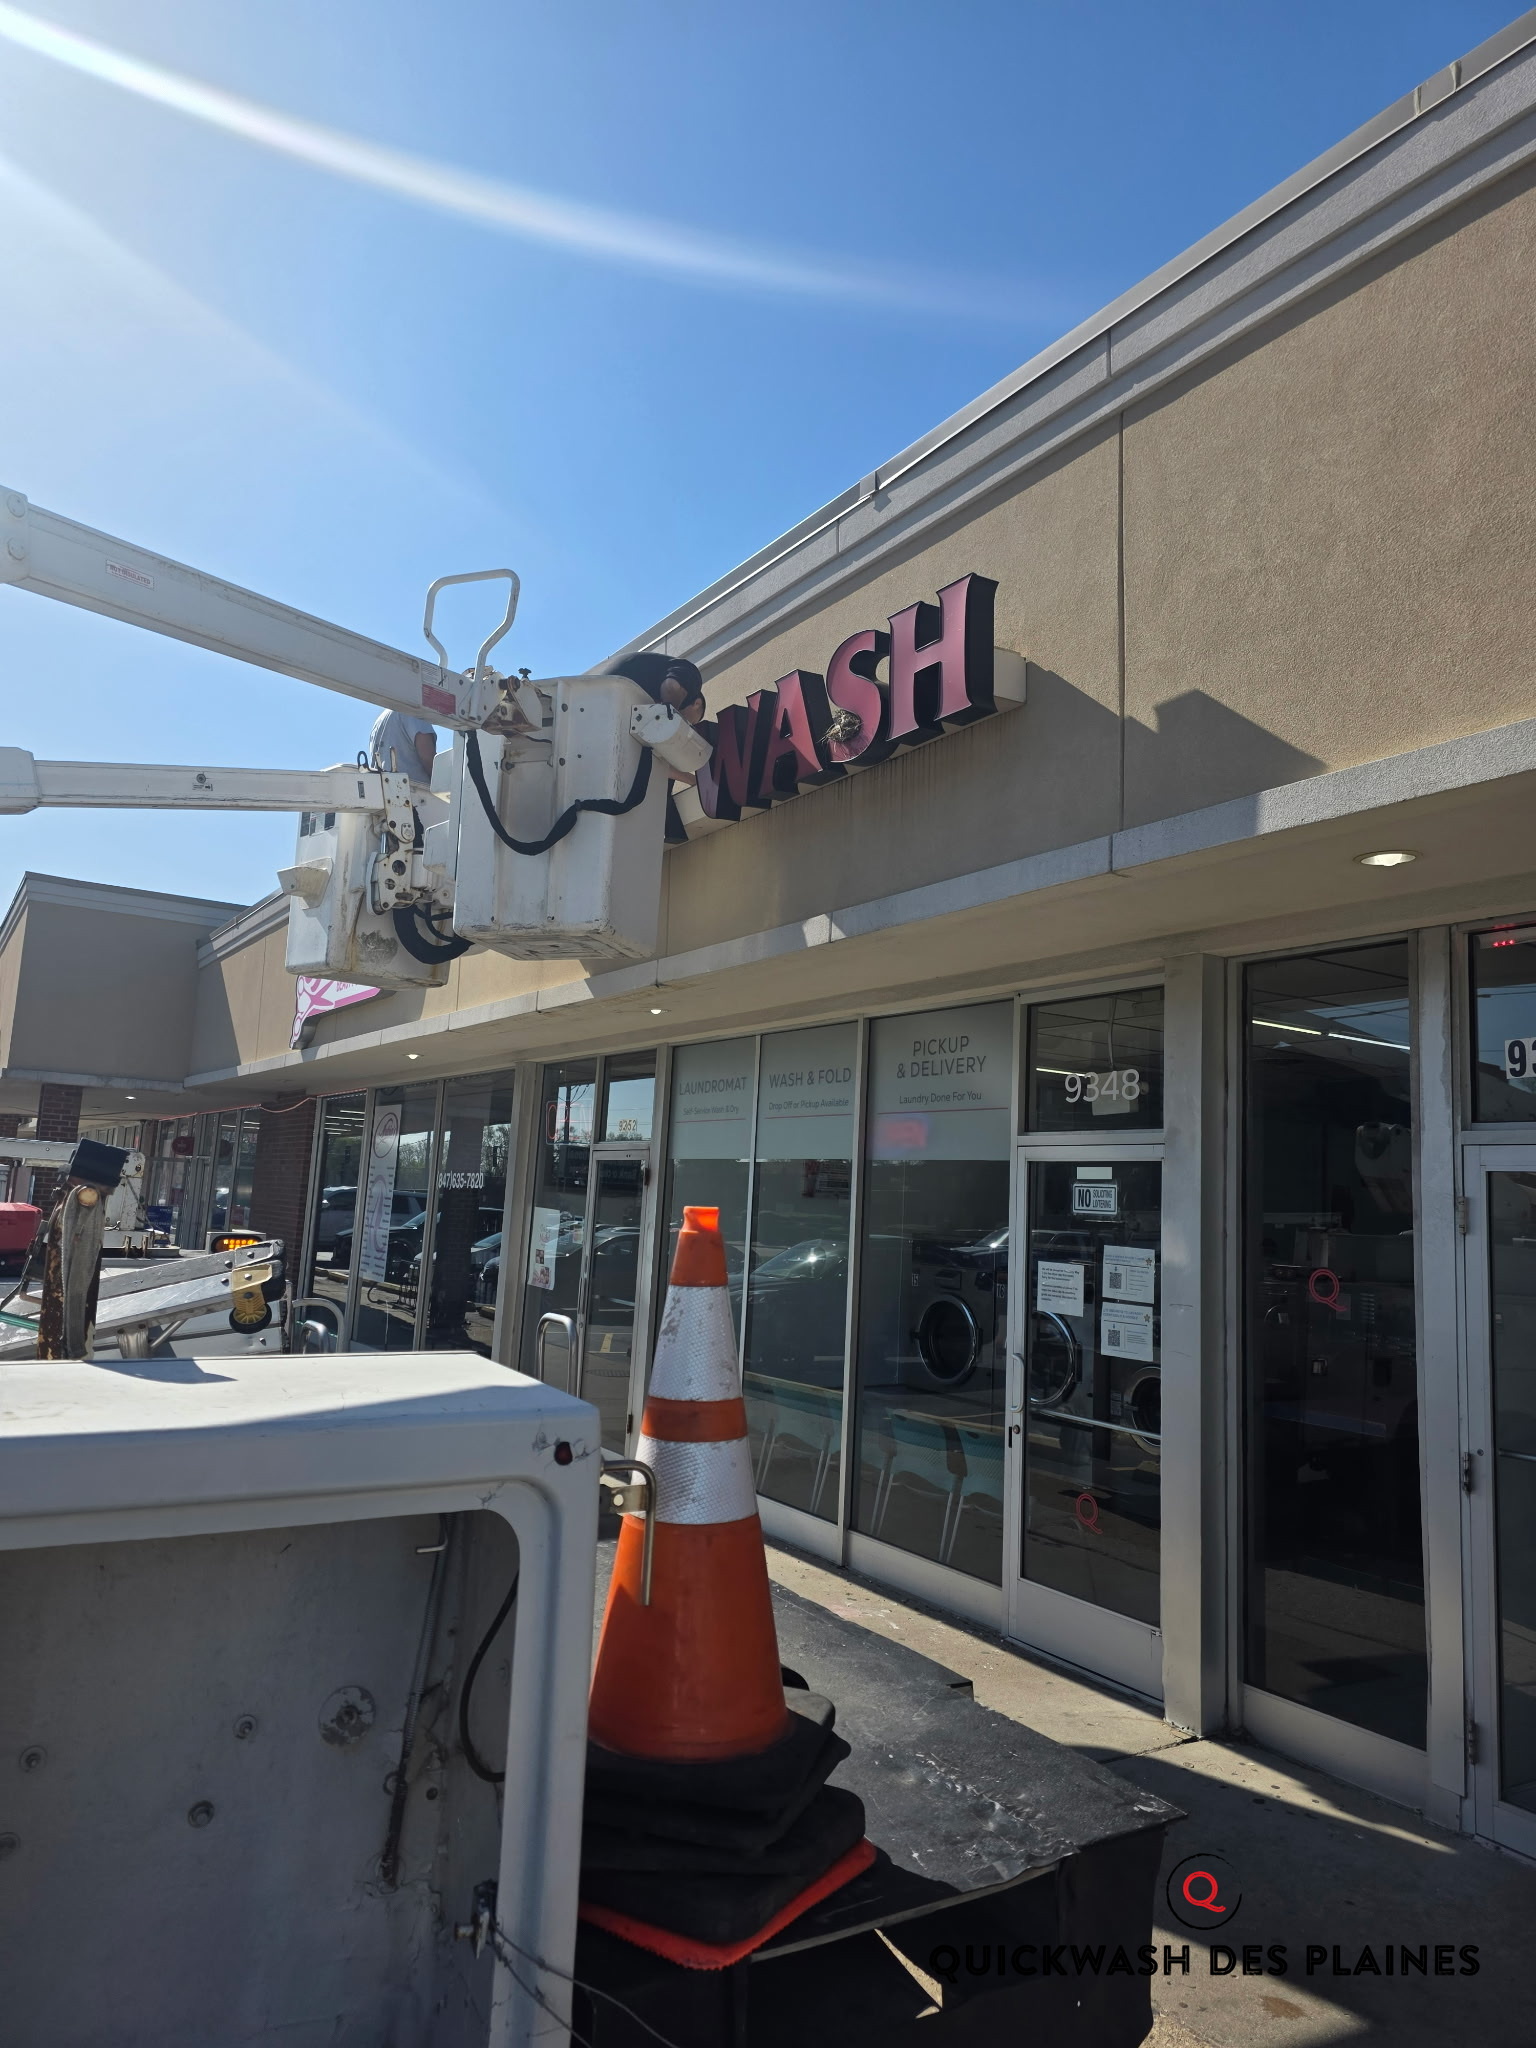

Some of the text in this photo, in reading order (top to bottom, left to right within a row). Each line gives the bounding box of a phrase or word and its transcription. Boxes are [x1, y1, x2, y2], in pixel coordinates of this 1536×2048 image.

[694, 572, 999, 822] WASH
[913, 1035, 970, 1057] PICKUP
[896, 1055, 987, 1078] & DELIVERY
[1508, 1039, 1536, 1078] 9
[679, 1076, 748, 1096] LAUNDROMAT
[769, 1067, 852, 1089] WASH & FOLD
[1065, 1069, 1140, 1103] 9348
[768, 1101, 783, 1113] Drop
[783, 1100, 793, 1110] Off
[800, 1099, 819, 1110] Pickup
[820, 1097, 849, 1108] Available
[899, 1090, 982, 1106] Laundry Done For You
[1077, 1188, 1113, 1208] NO SOLICITING
[1309, 1268, 1347, 1312] Q
[1076, 1493, 1103, 1534] Q
